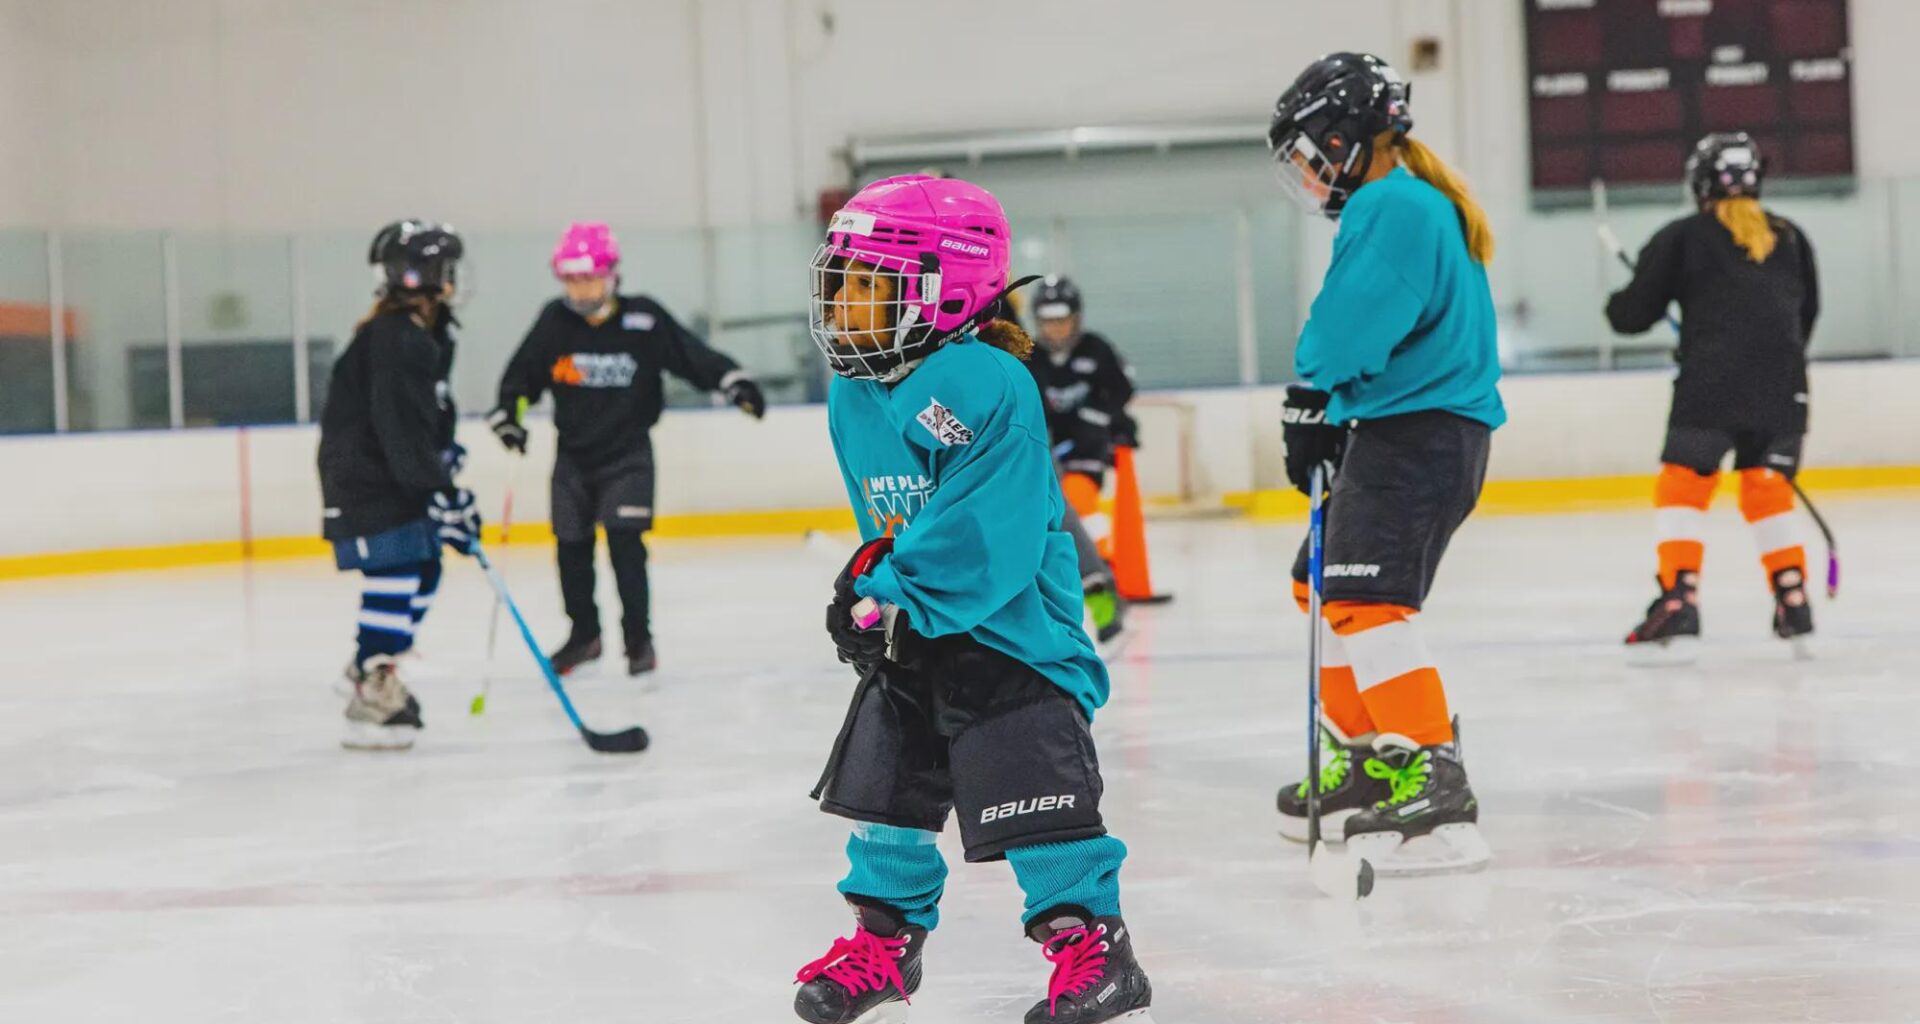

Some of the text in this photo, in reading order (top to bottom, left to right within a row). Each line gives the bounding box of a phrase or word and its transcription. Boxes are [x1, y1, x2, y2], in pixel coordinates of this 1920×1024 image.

[941, 239, 989, 257] BAUER
[870, 475, 896, 493] WE
[980, 794, 1075, 825] BAUER
